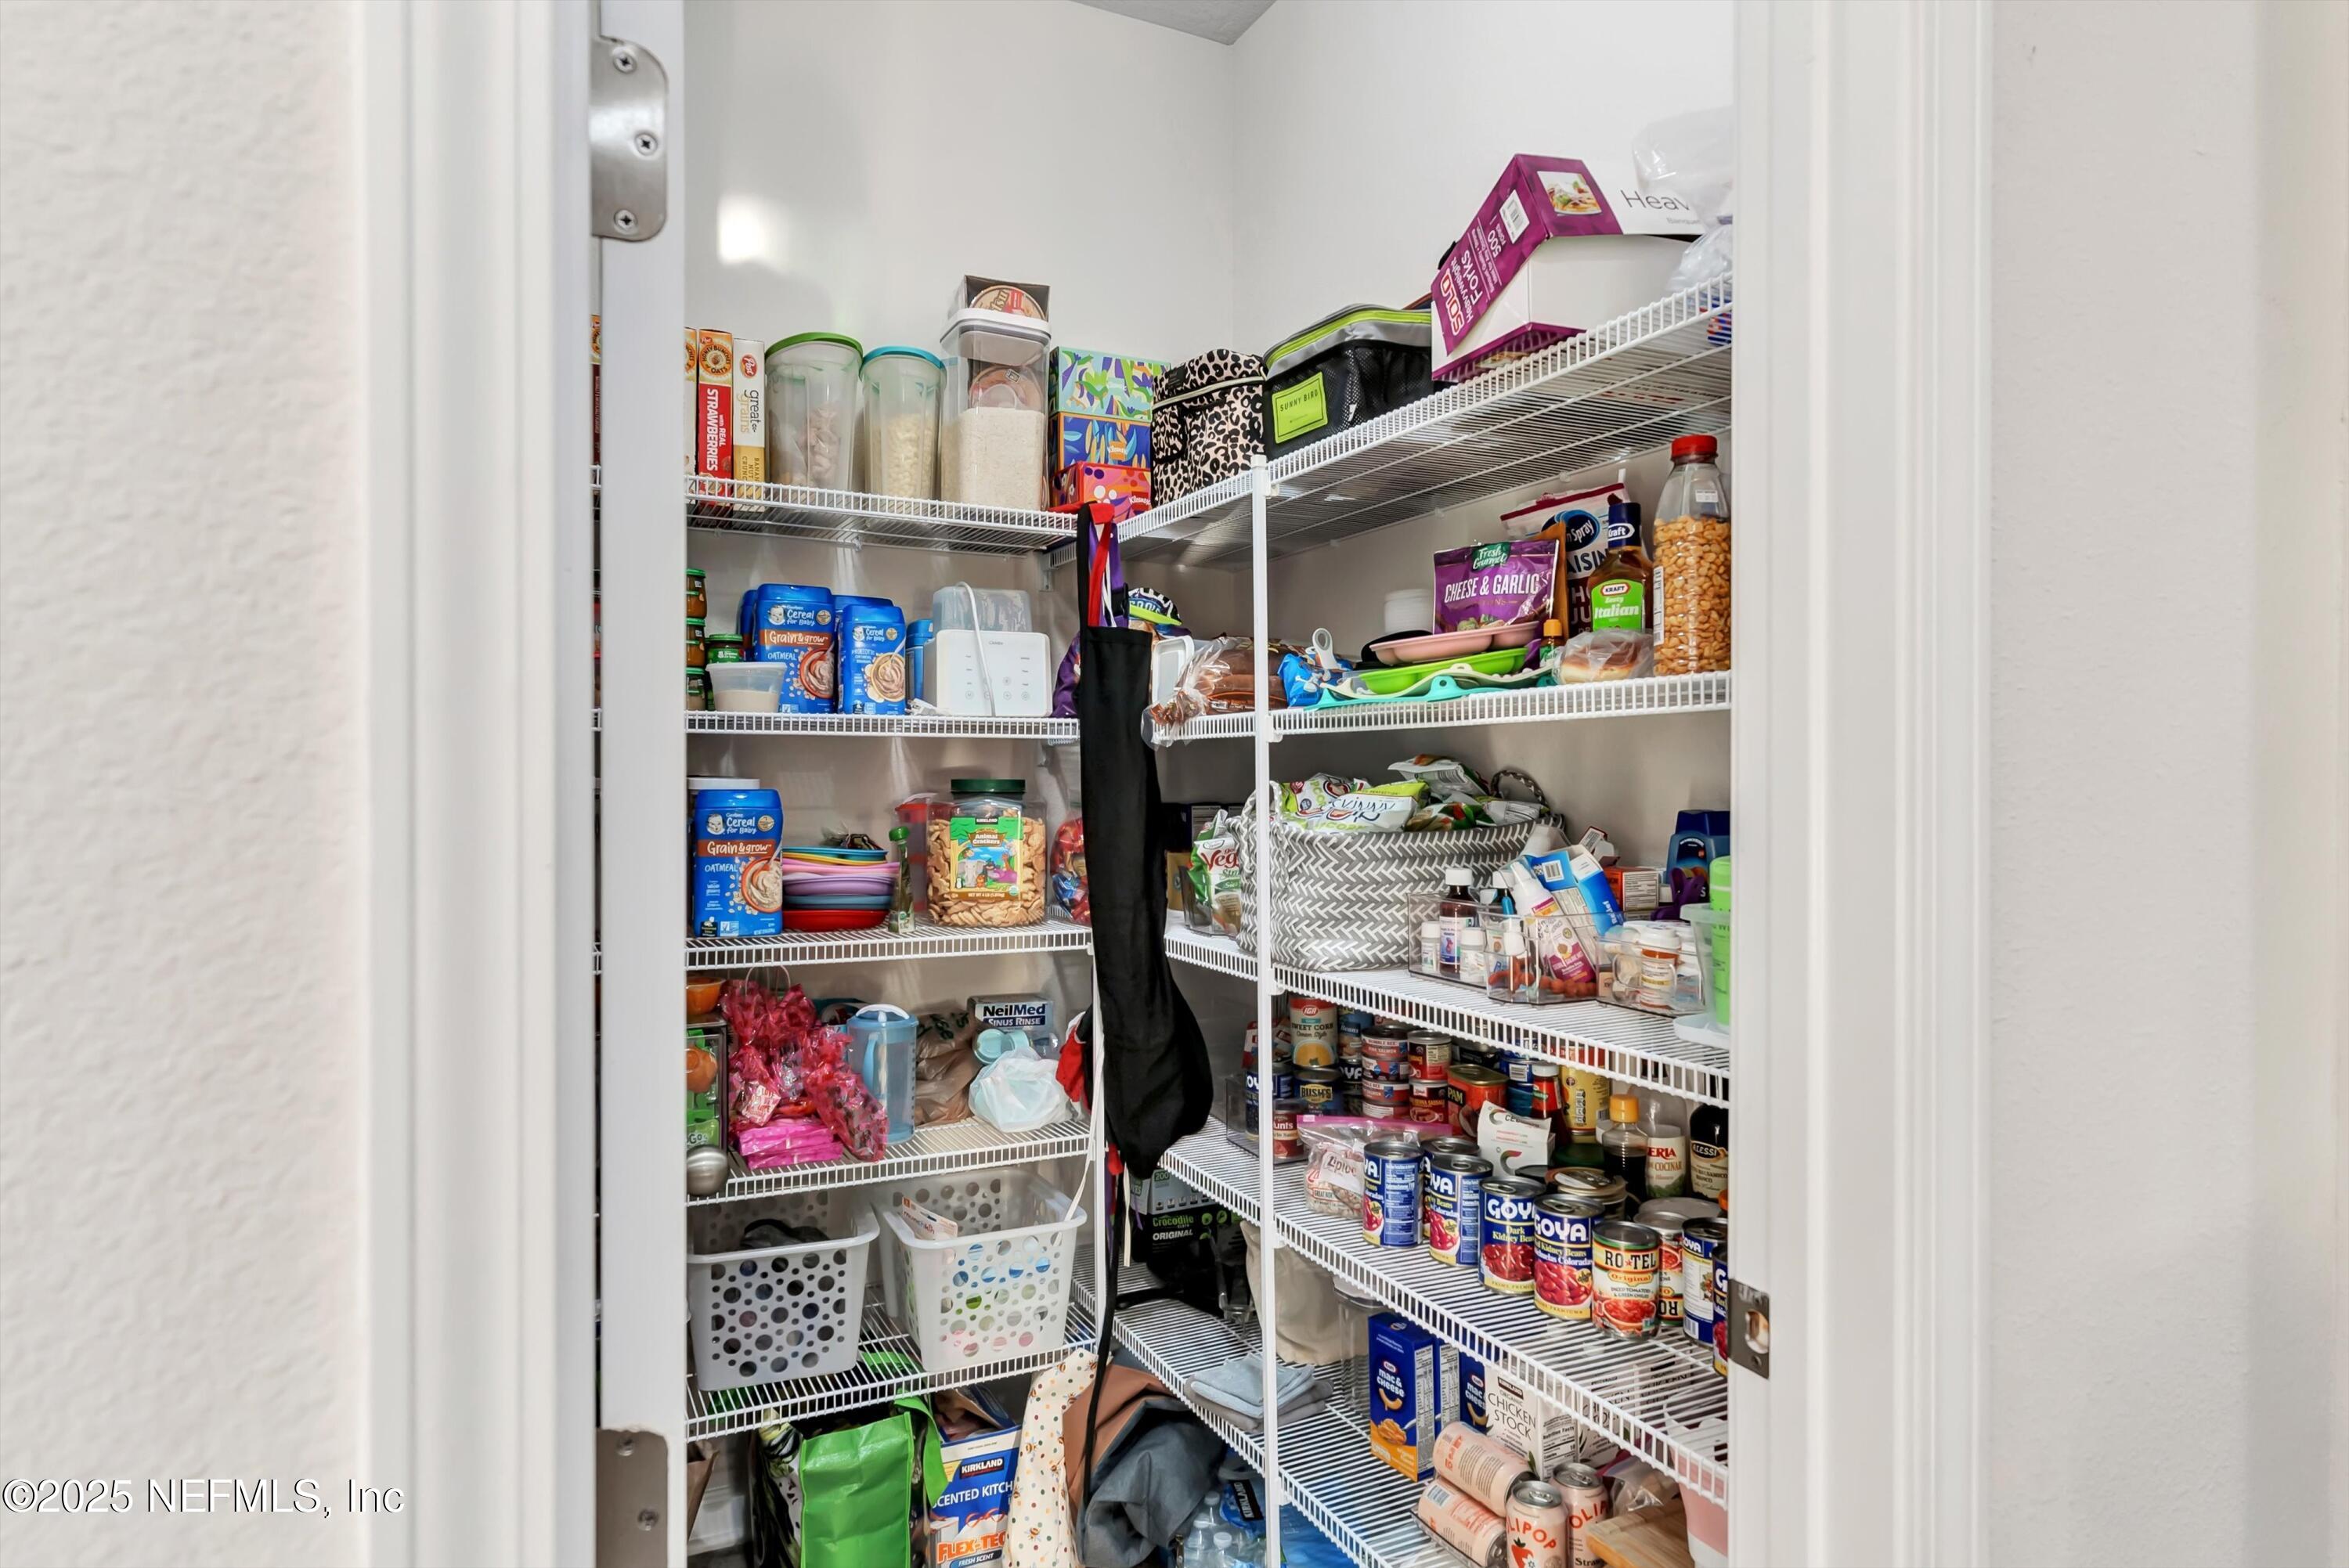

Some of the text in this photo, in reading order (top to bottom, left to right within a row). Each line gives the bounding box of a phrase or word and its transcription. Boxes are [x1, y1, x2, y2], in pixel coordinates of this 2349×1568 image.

[1488, 230, 1502, 258] 500
[1461, 250, 1482, 306] Forks
[1451, 257, 1473, 323] Heavyweight
[1440, 269, 1464, 336] SOLO
[743, 357, 756, 375] Post
[744, 390, 761, 424] great
[1279, 398, 1301, 412] SUNNY
[737, 393, 750, 434] grains
[706, 388, 719, 471] STRAWBERRIES
[1571, 520, 1594, 542] Spray
[1478, 545, 1503, 558] Fresh
[1567, 549, 1607, 574] AISIN
[1444, 573, 1540, 604] CHEESE & GARLIC
[787, 610, 815, 619] Cereal
[1594, 604, 1639, 619] Italian
[804, 636, 825, 645] grow
[767, 651, 797, 661] OATMEAL
[726, 816, 756, 827] Cereal
[706, 841, 738, 856] Grain
[745, 843, 768, 853] grow
[704, 863, 738, 873] OATMEAL
[983, 1004, 1046, 1017] NeilMed
[988, 1017, 1041, 1027] SINUS RINSE
[1449, 1088, 1463, 1105] PAM
[1647, 1147, 1676, 1160] ERIA
[1693, 1143, 1717, 1157] ALESSI
[1154, 1172, 1169, 1181] 200
[1487, 1199, 1535, 1220] GOY
[1153, 1214, 1194, 1227] Crocodile
[1534, 1214, 1587, 1242] GOYA
[1153, 1228, 1194, 1242] ORIGINAL
[1492, 1231, 1517, 1243] Kidney
[1506, 1226, 1525, 1235] Dark
[1540, 1242, 1587, 1257] Kidney Beans
[1684, 1238, 1702, 1253] OYA
[1630, 1253, 1657, 1270] TEL
[1611, 1273, 1651, 1282] Original
[1378, 1368, 1402, 1388] mac &
[1467, 1382, 1483, 1398] mac
[1487, 1392, 1537, 1429] CHICKEN
[1493, 1409, 1532, 1441] STOCK
[962, 1458, 1004, 1474] KIRKLAND
[981, 1480, 1013, 1498] KITCH
[1233, 1482, 1254, 1518] KIRKLAND
[1506, 1516, 1557, 1549] LIPOP
[937, 1530, 1006, 1564] FLEX-TEC
[958, 1552, 994, 1567] FRESH SCENT
